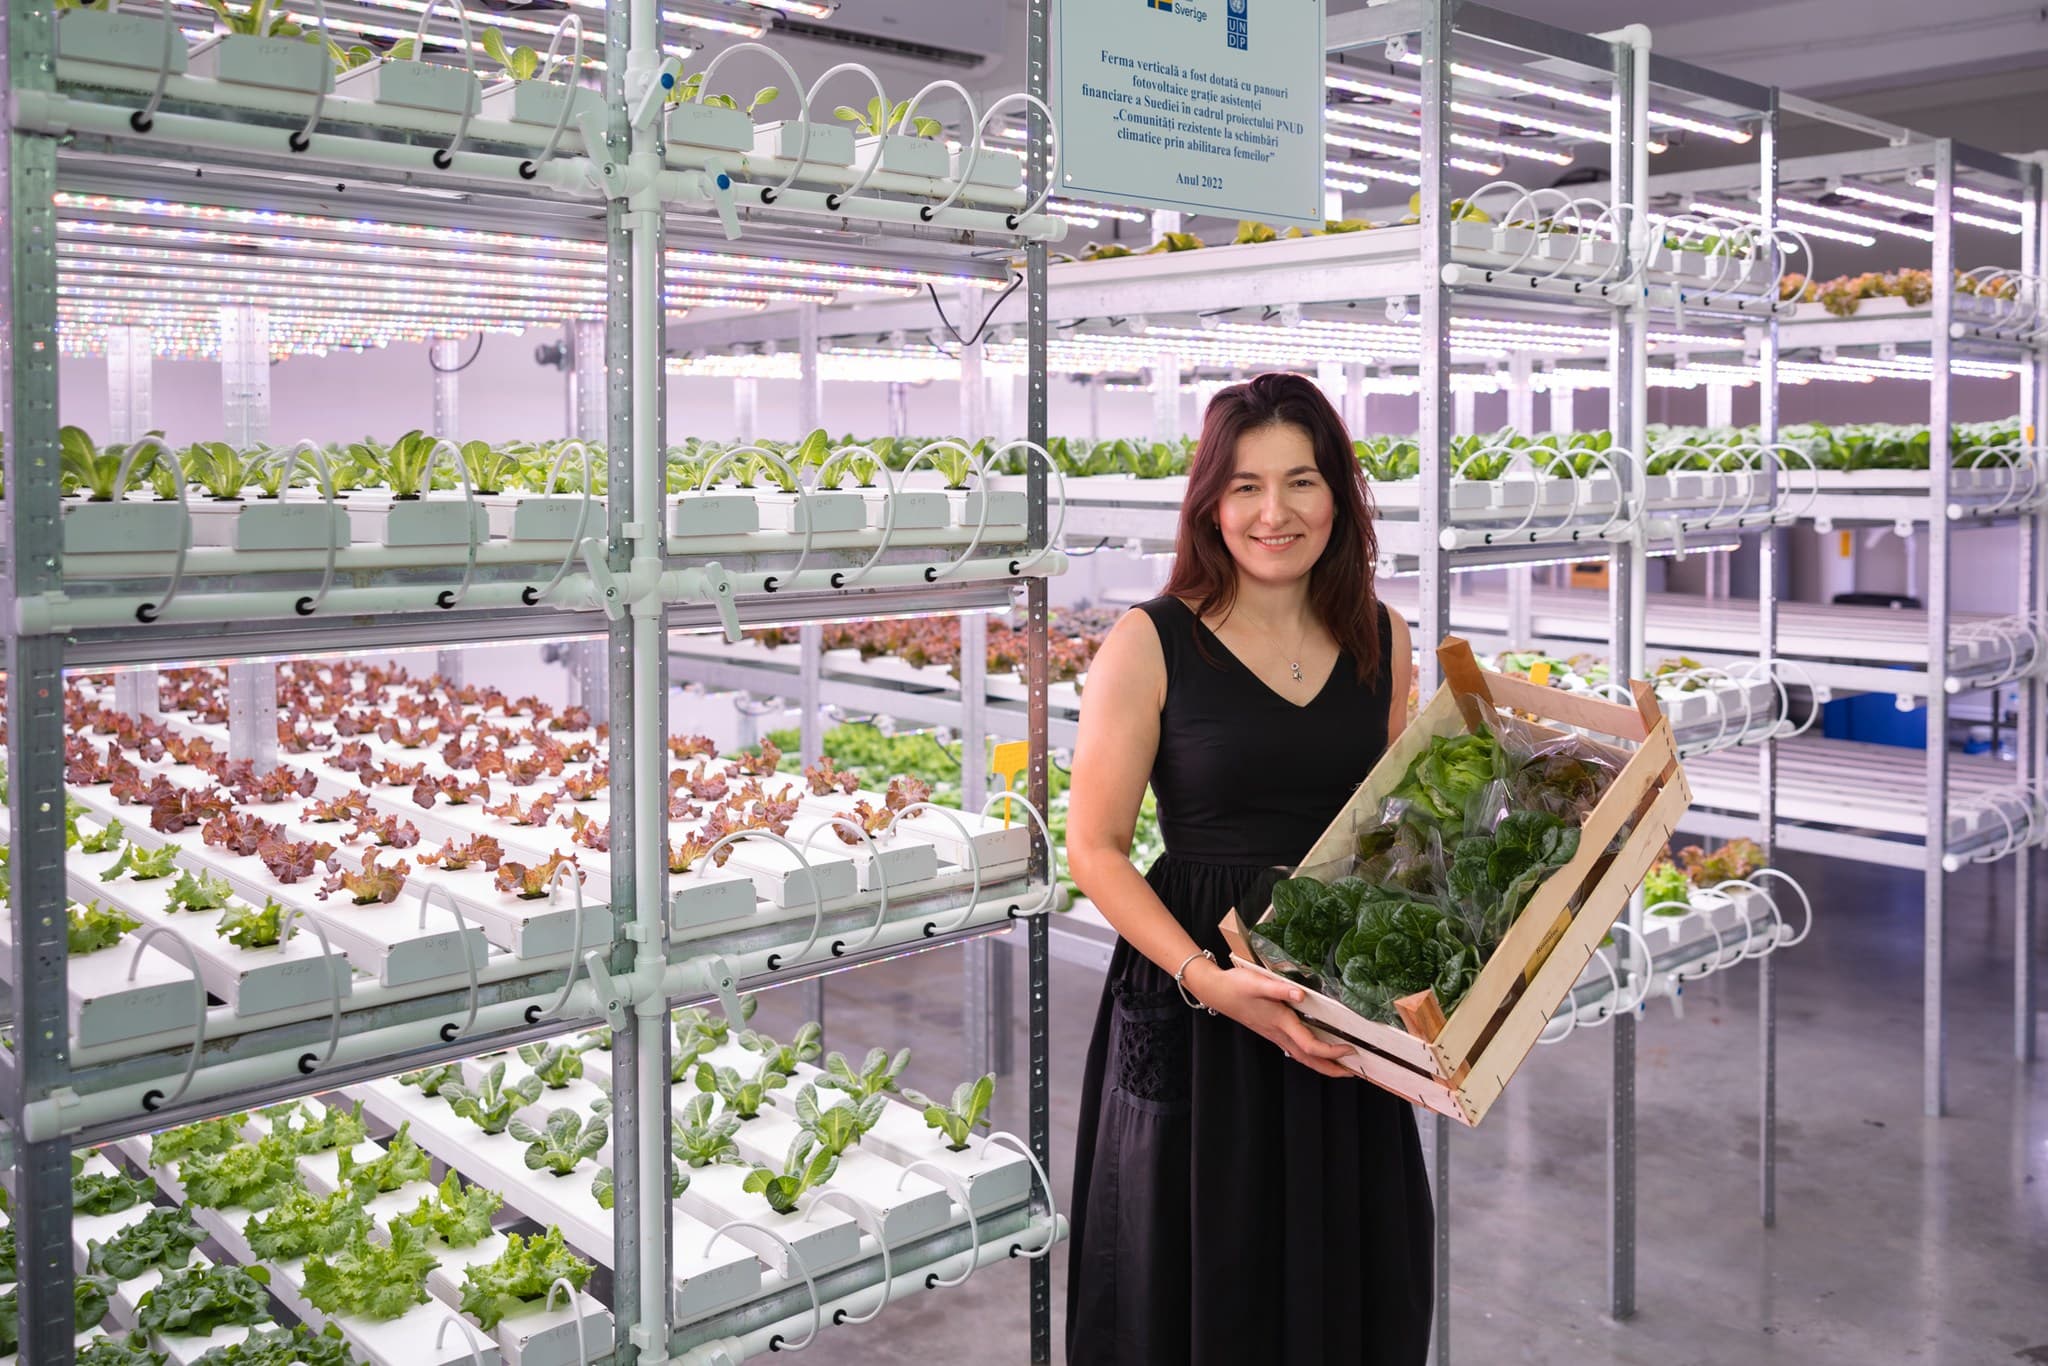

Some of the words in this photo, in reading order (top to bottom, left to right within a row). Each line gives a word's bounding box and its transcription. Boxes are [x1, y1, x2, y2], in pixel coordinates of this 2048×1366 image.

[1174, 2, 1208, 22] Sverige
[1101, 49, 1134, 68] Ferma
[1137, 60, 1179, 78] verticală
[1182, 69, 1187, 79] a
[1190, 68, 1207, 82] fost
[1209, 73, 1238, 89] dotată
[1241, 81, 1251, 92] cu
[1254, 84, 1288, 99] panouri
[1132, 75, 1188, 97] fotovoltaice
[1220, 93, 1262, 112] asistenței
[1082, 83, 1133, 105] financiare
[1136, 96, 1142, 106] a
[1144, 95, 1180, 113] Suediei
[1182, 101, 1191, 115] în
[1194, 107, 1224, 121] cadrul
[1226, 112, 1274, 130] proiectului
[1276, 119, 1304, 135] PNUD
[1117, 127, 1162, 145] climatice
[1164, 135, 1184, 149] prin
[1187, 139, 1231, 156] abilitarea
[1177, 121, 1222, 138] rezistente
[1224, 127, 1232, 139] la
[1235, 129, 1279, 148] schimbări
[1176, 172, 1199, 186] Anul
[1201, 175, 1223, 190] 2022
